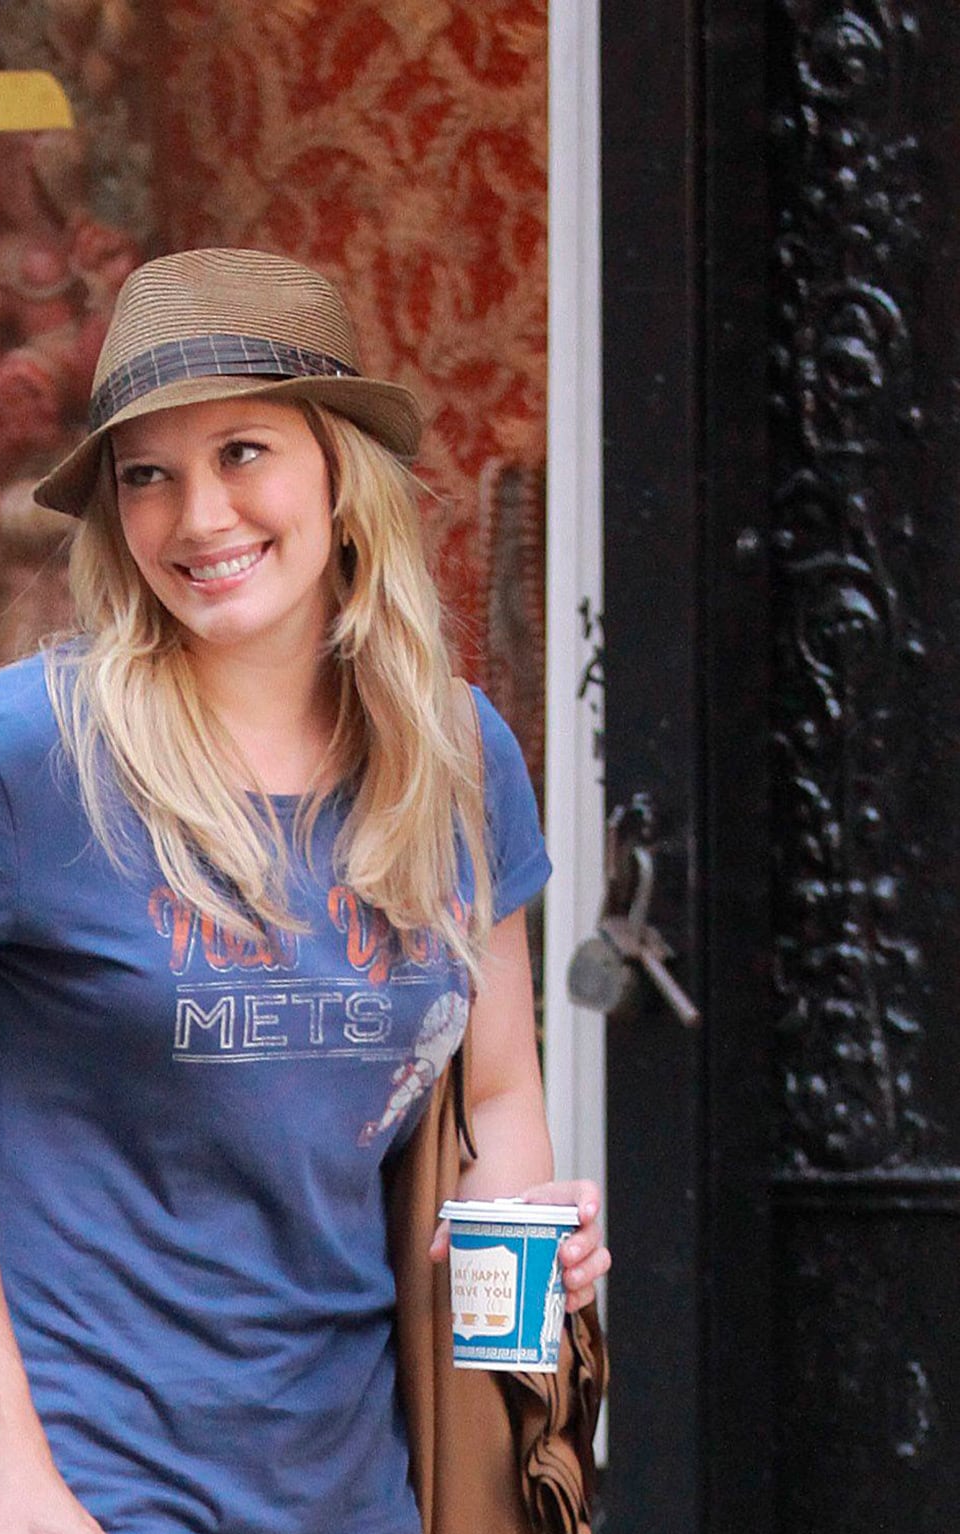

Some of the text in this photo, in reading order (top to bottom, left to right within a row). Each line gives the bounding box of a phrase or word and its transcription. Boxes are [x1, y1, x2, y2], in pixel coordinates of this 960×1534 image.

[174, 991, 392, 1049] METS
[471, 1269, 510, 1282] HAPPY
[484, 1286, 512, 1300] YOU
